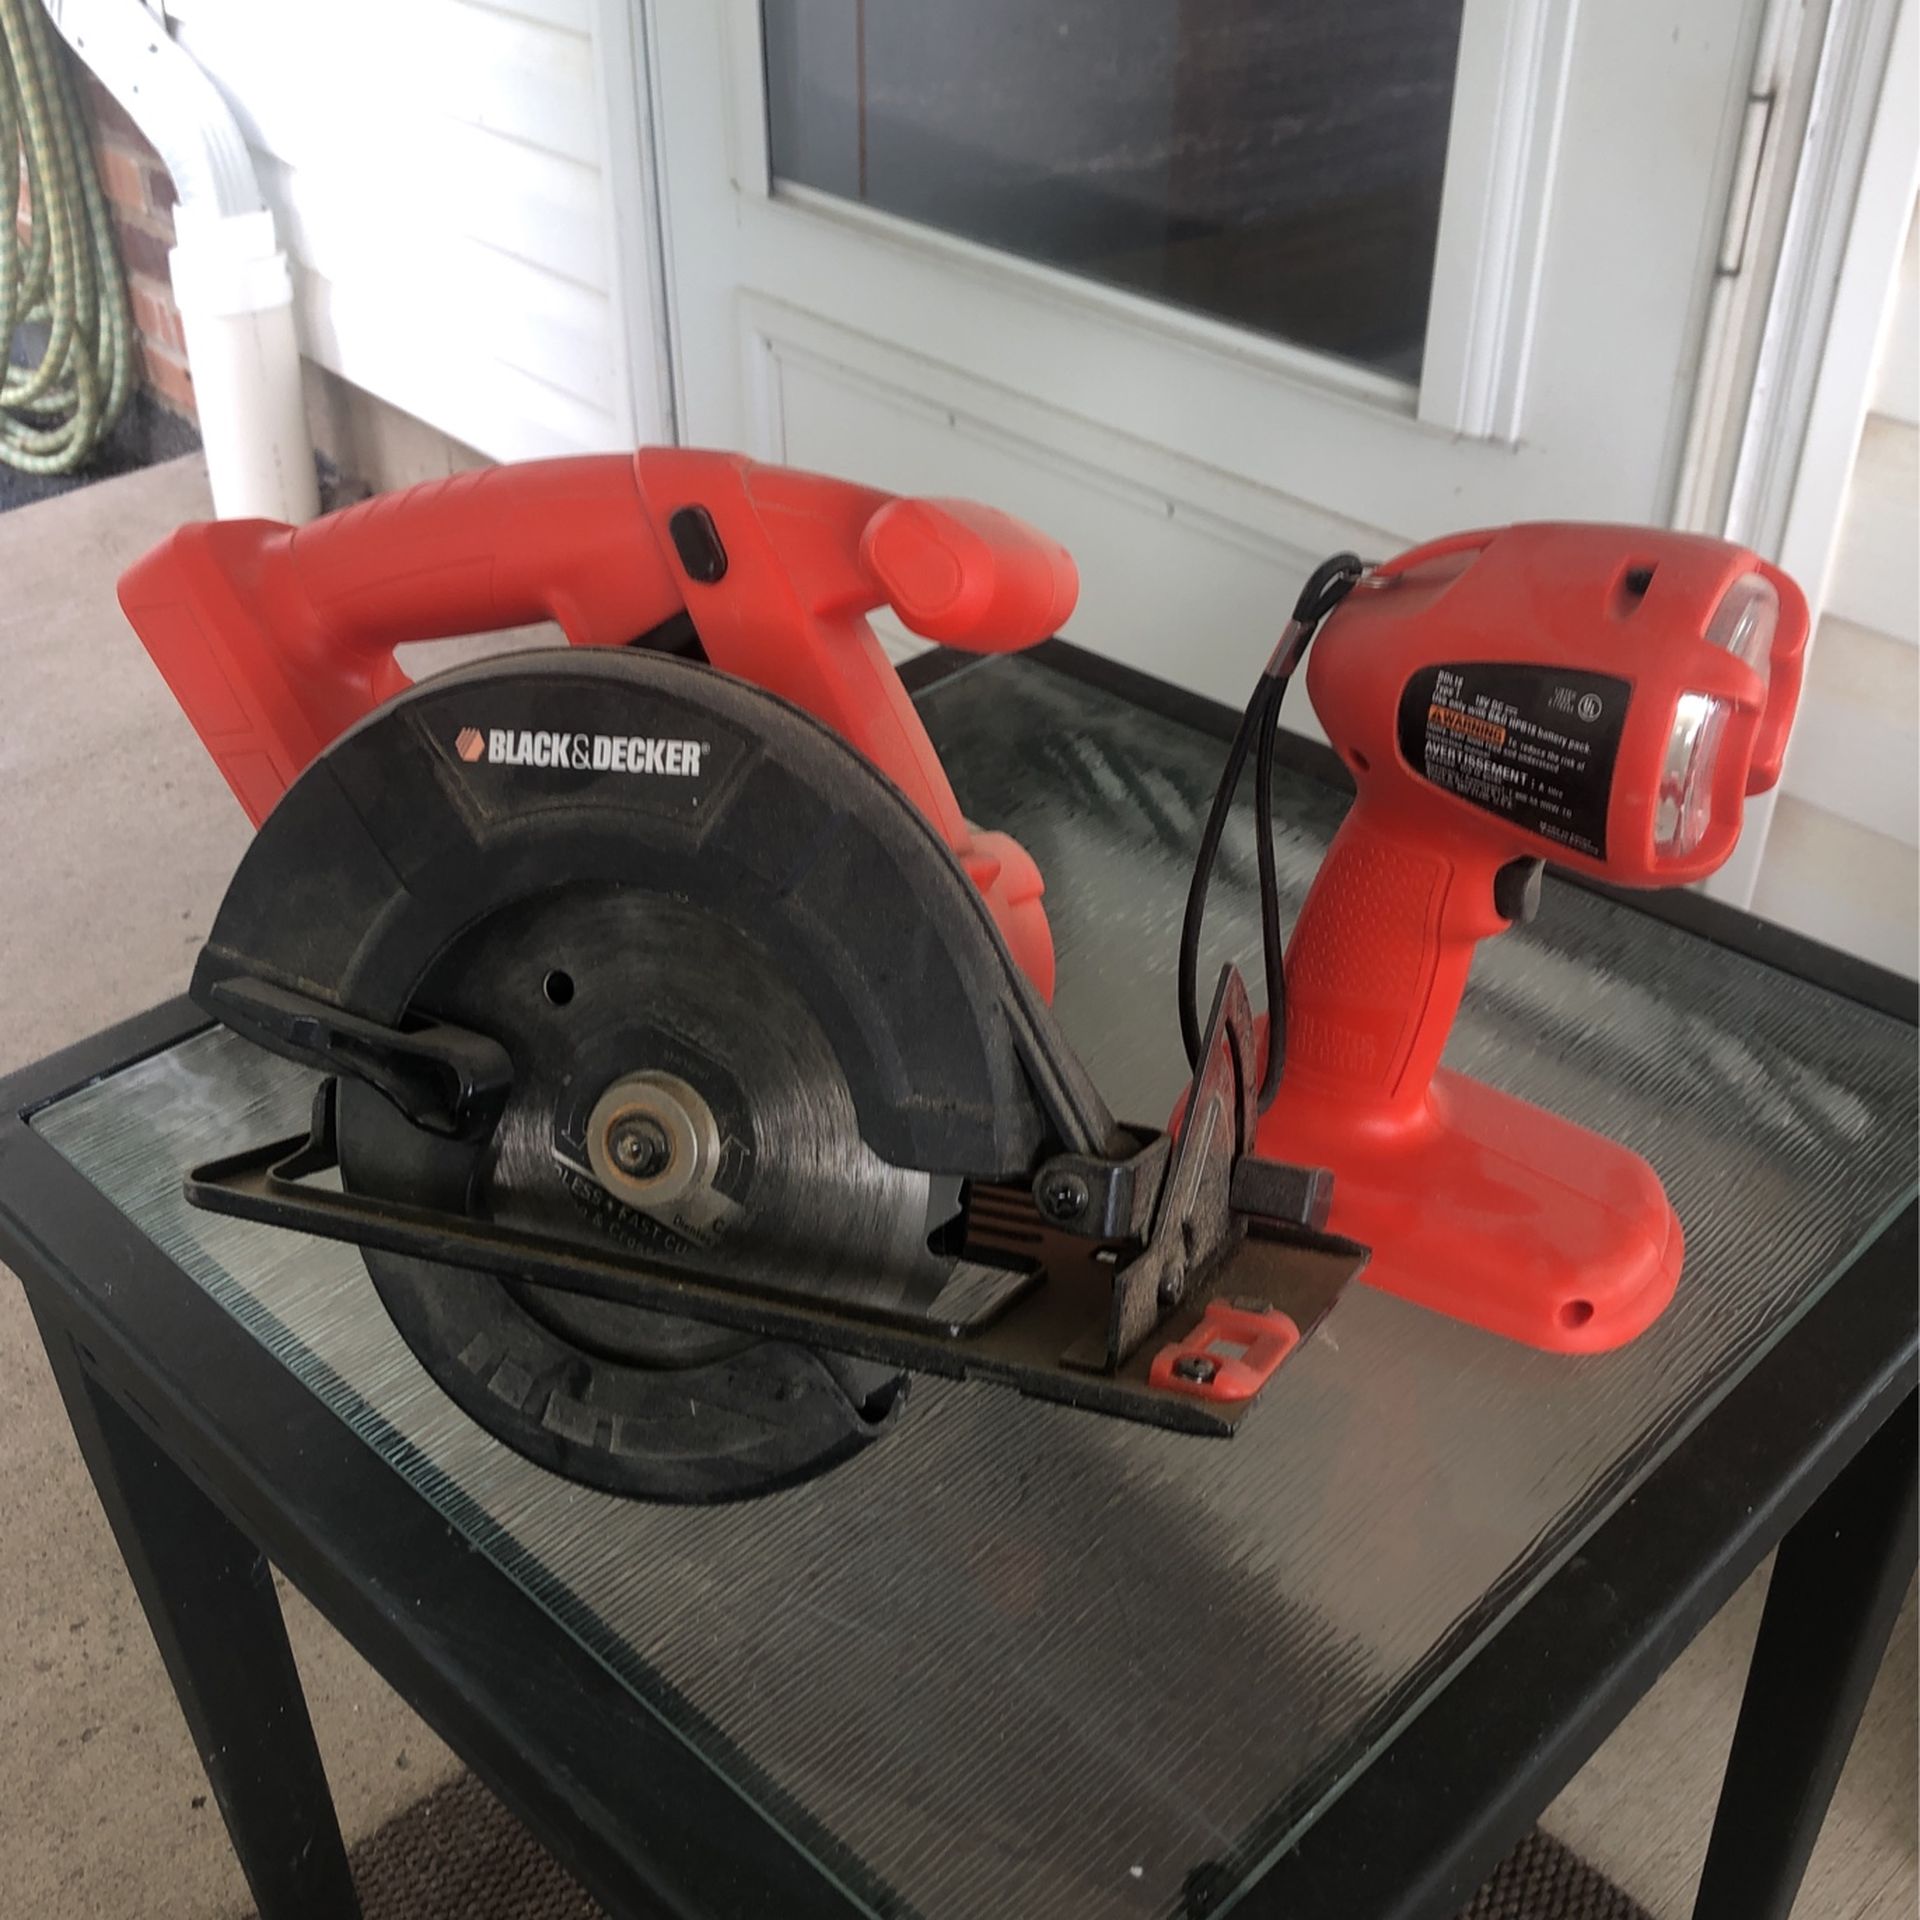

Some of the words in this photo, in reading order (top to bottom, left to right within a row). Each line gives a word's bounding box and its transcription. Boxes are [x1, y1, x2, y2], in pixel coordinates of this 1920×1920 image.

[1446, 709, 1503, 743] WARNING
[1448, 699, 1466, 714] only
[1467, 704, 1486, 718] with
[1537, 726, 1568, 749] battery
[1425, 740, 1528, 786] AVERTISSEMENT
[1547, 750, 1559, 763] the
[1560, 756, 1575, 769] risk
[1576, 761, 1586, 773] of
